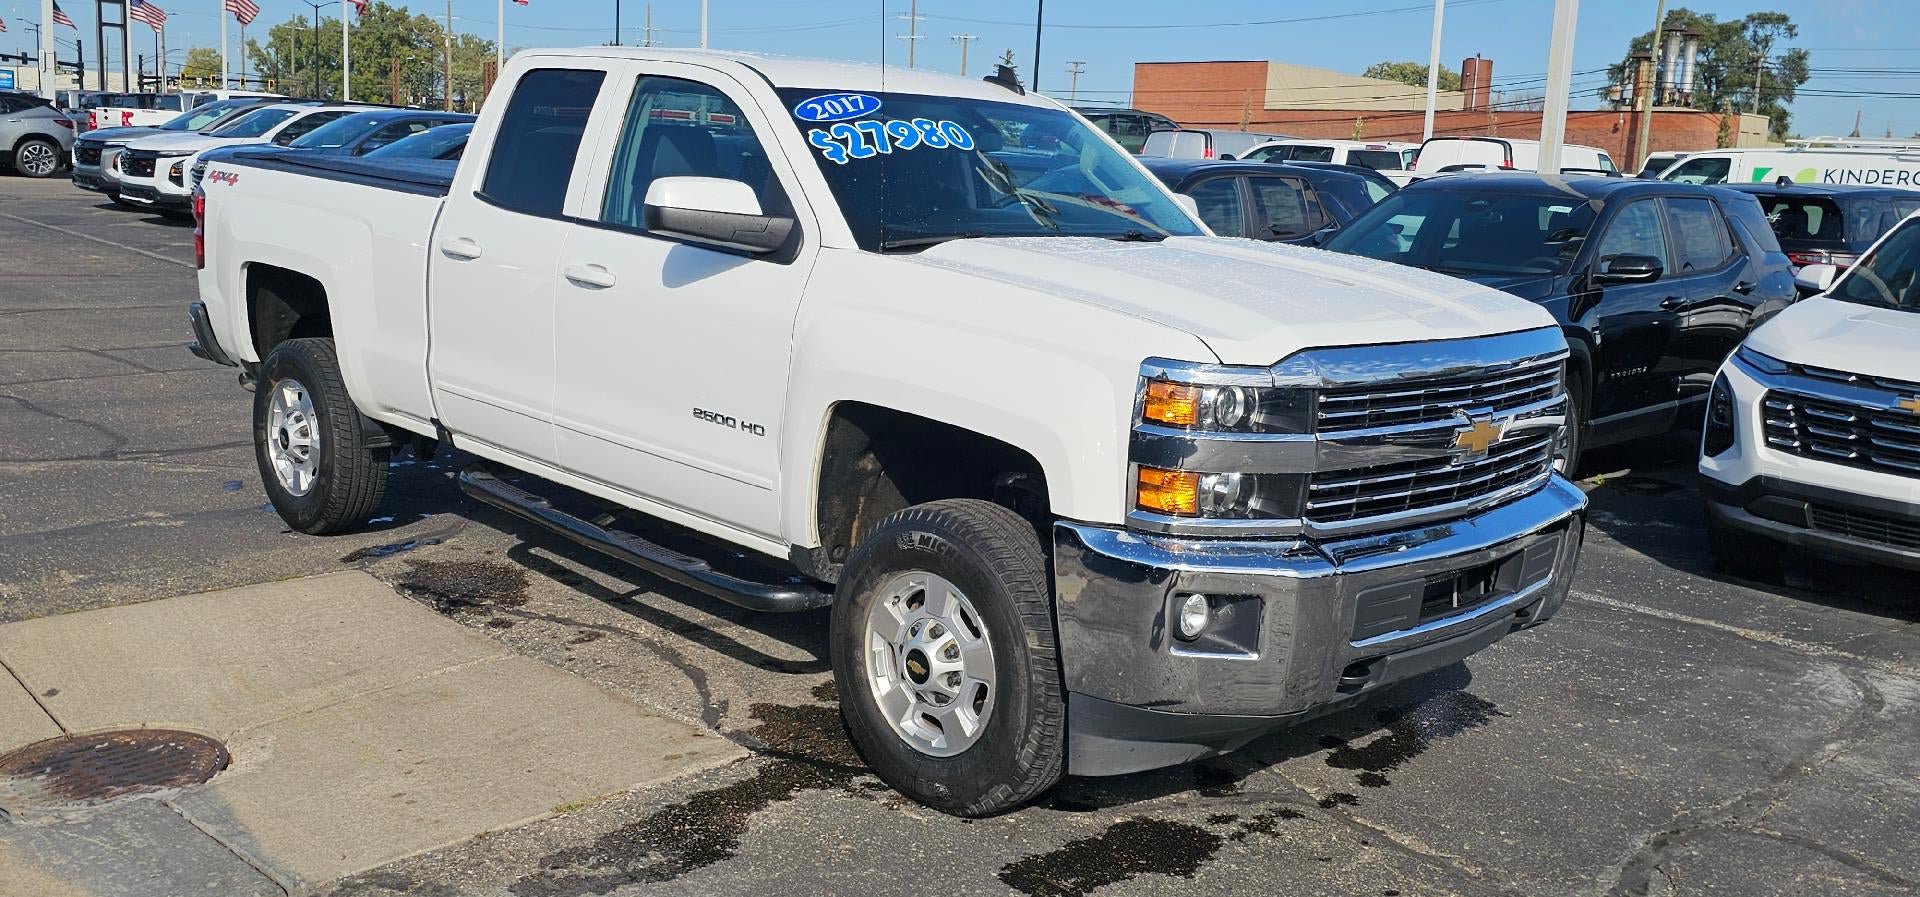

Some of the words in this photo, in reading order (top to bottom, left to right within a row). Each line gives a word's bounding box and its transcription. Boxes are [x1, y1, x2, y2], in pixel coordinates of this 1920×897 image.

[807, 95, 866, 120] 2017
[808, 118, 975, 165] $27980
[741, 420, 765, 437] HD
